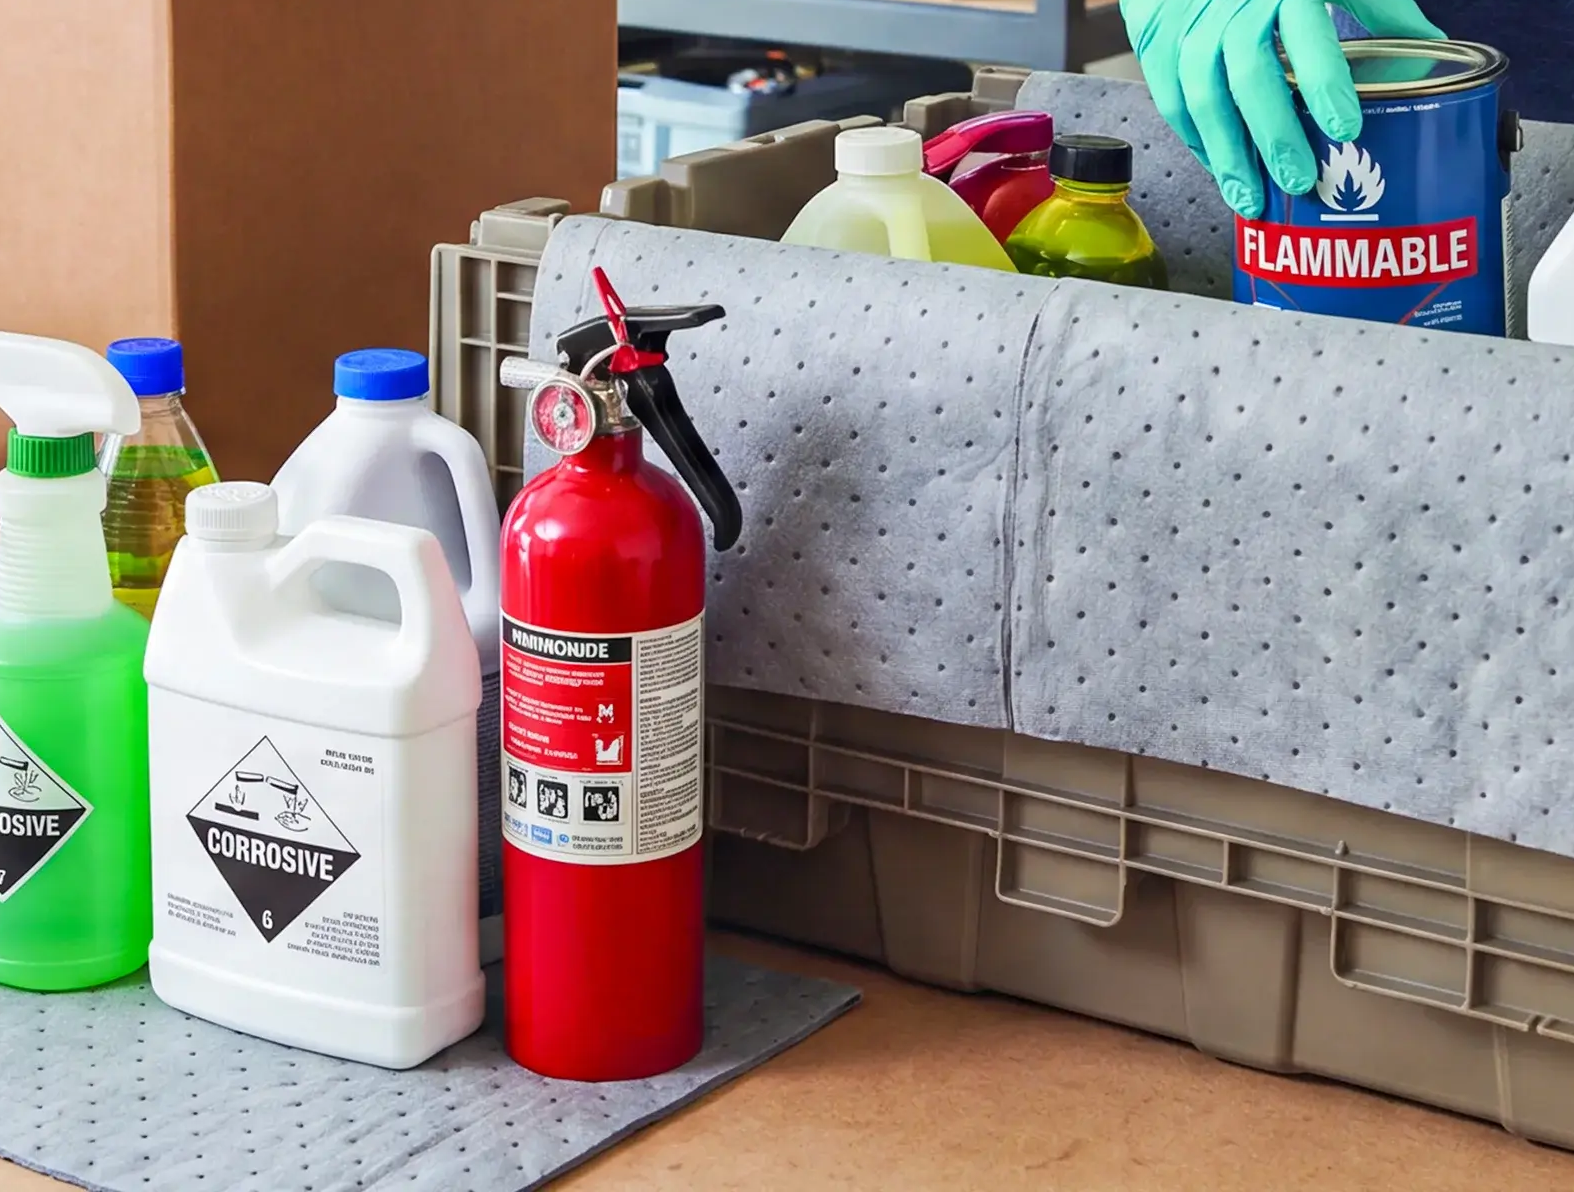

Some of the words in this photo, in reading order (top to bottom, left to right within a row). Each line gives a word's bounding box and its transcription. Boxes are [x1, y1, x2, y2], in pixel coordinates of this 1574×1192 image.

[1243, 226, 1468, 278] FLAMMABLE
[207, 827, 335, 882] CORROSIVE
[261, 909, 274, 930] 6
